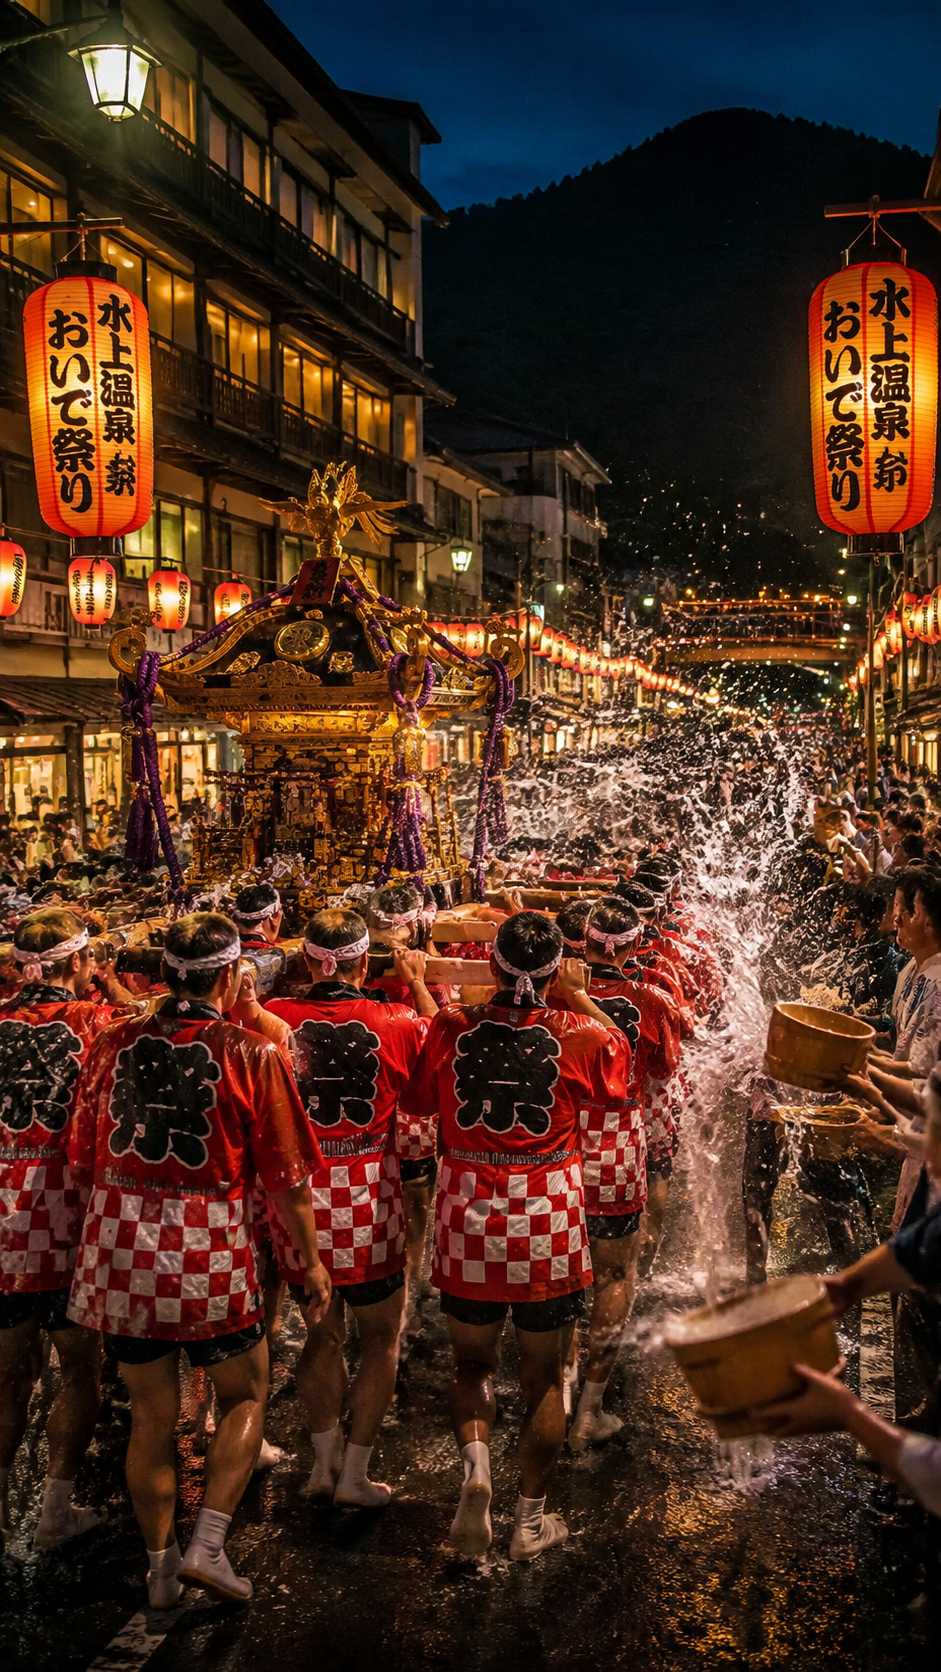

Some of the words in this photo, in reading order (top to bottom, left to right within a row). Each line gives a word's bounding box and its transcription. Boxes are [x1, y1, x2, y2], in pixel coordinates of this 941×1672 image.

[48, 309, 96, 513] おいで祭り
[824, 300, 865, 512] おいで祭り
[108, 1034, 222, 1169] 祭
[452, 1020, 561, 1136] 祭
